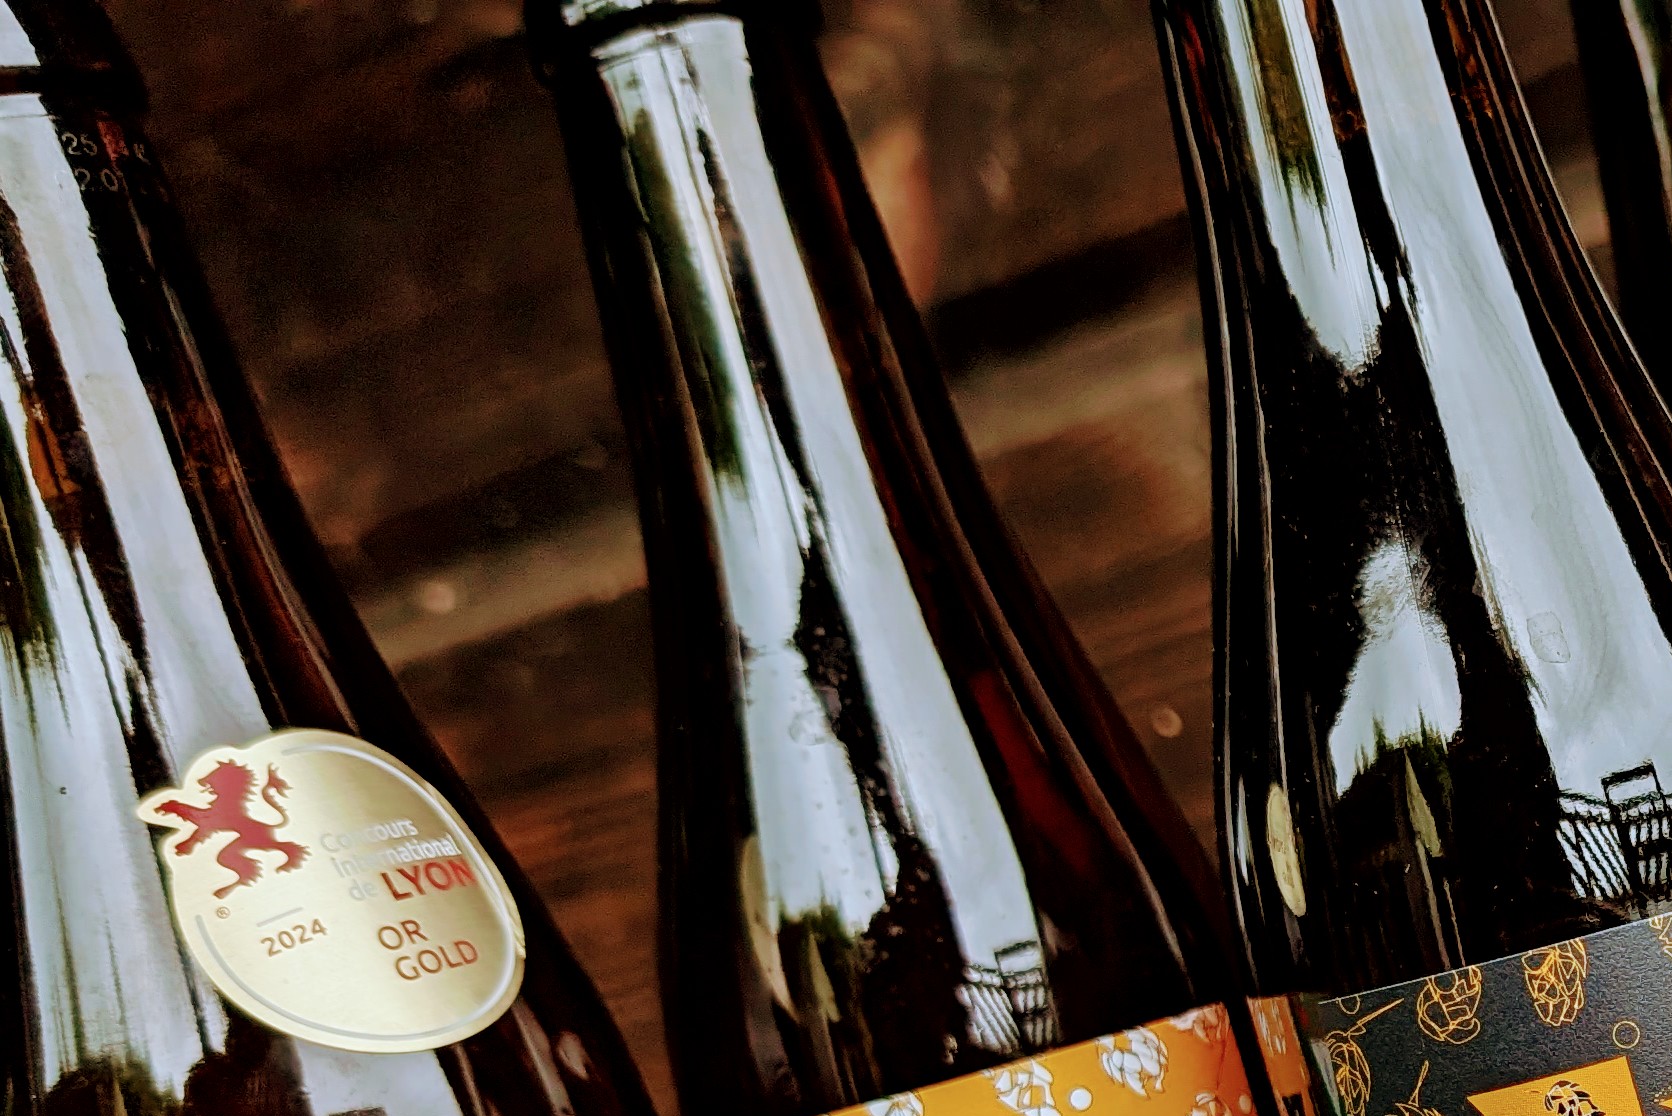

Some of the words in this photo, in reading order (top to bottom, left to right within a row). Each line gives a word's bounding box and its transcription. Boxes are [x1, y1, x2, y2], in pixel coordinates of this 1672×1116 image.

[350, 880, 379, 900] de
[381, 858, 477, 901] LYON
[260, 918, 329, 957] 2024
[378, 919, 429, 950] OR
[395, 940, 478, 981] GOLD
